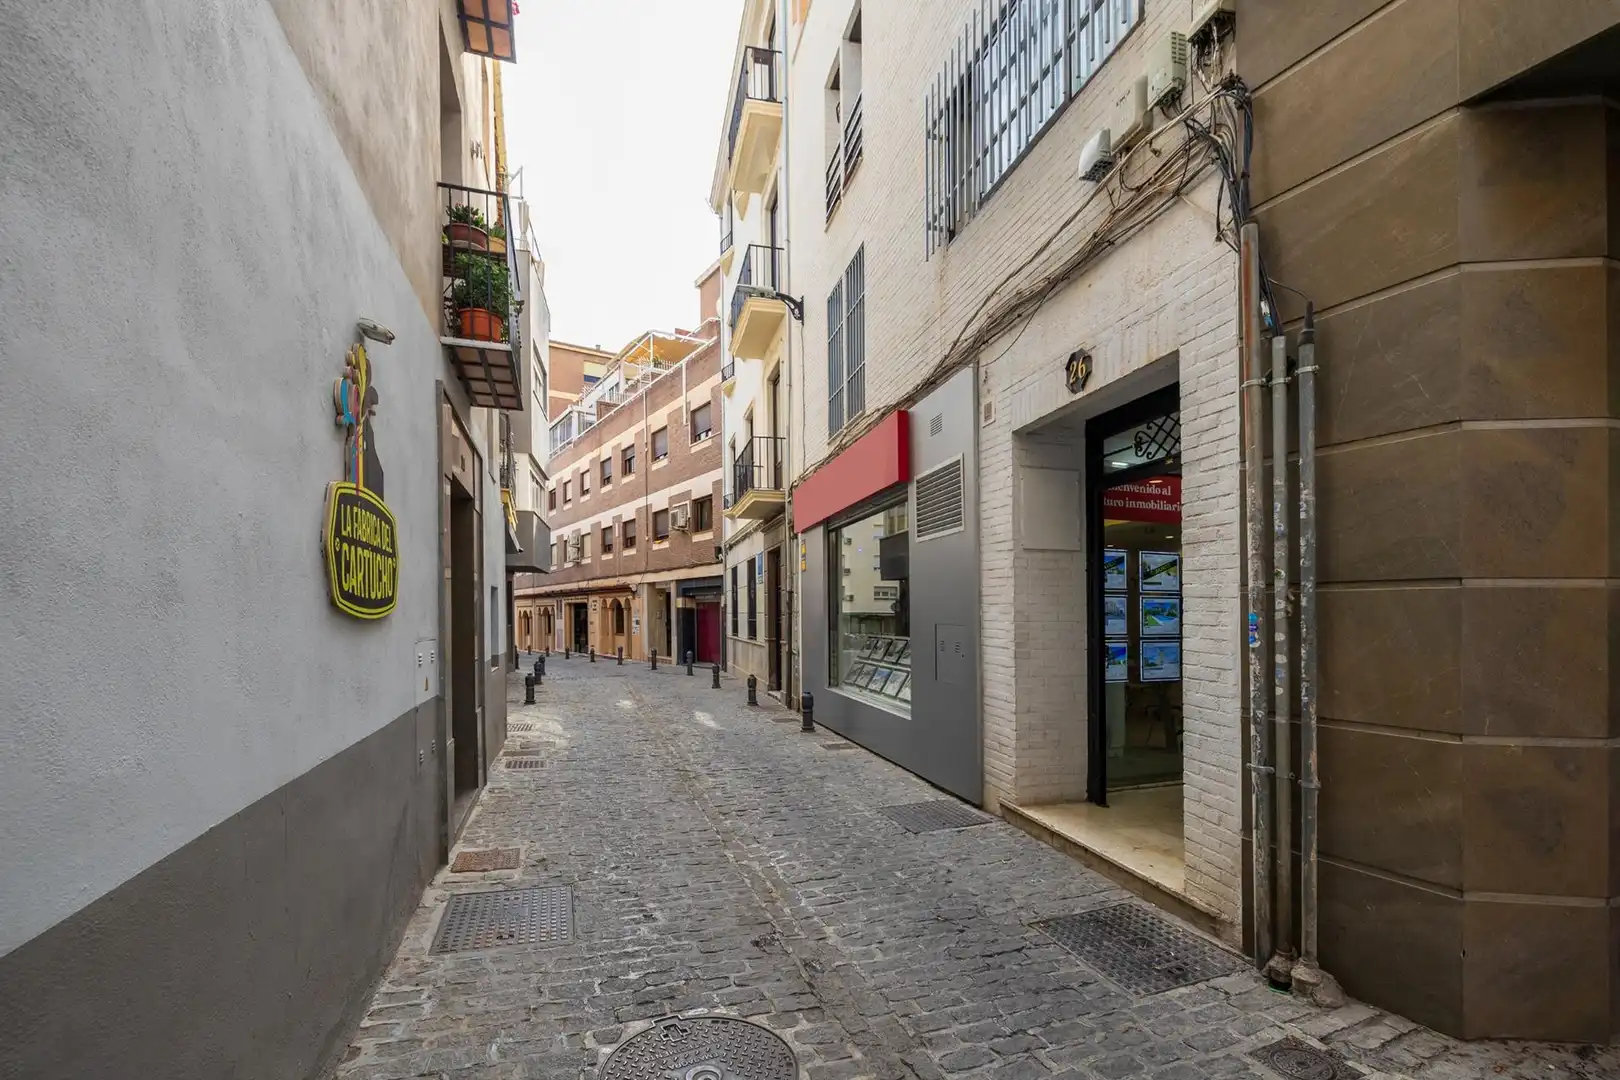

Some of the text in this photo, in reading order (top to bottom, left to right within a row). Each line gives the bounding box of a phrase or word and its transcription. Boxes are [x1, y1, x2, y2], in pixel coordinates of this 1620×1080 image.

[1069, 356, 1086, 385] 26
[1108, 483, 1172, 496] envenido al
[1125, 497, 1181, 511] inmobiliari
[341, 503, 352, 538] LA
[381, 520, 393, 554] DEL
[342, 542, 394, 600] CARTUCHO
